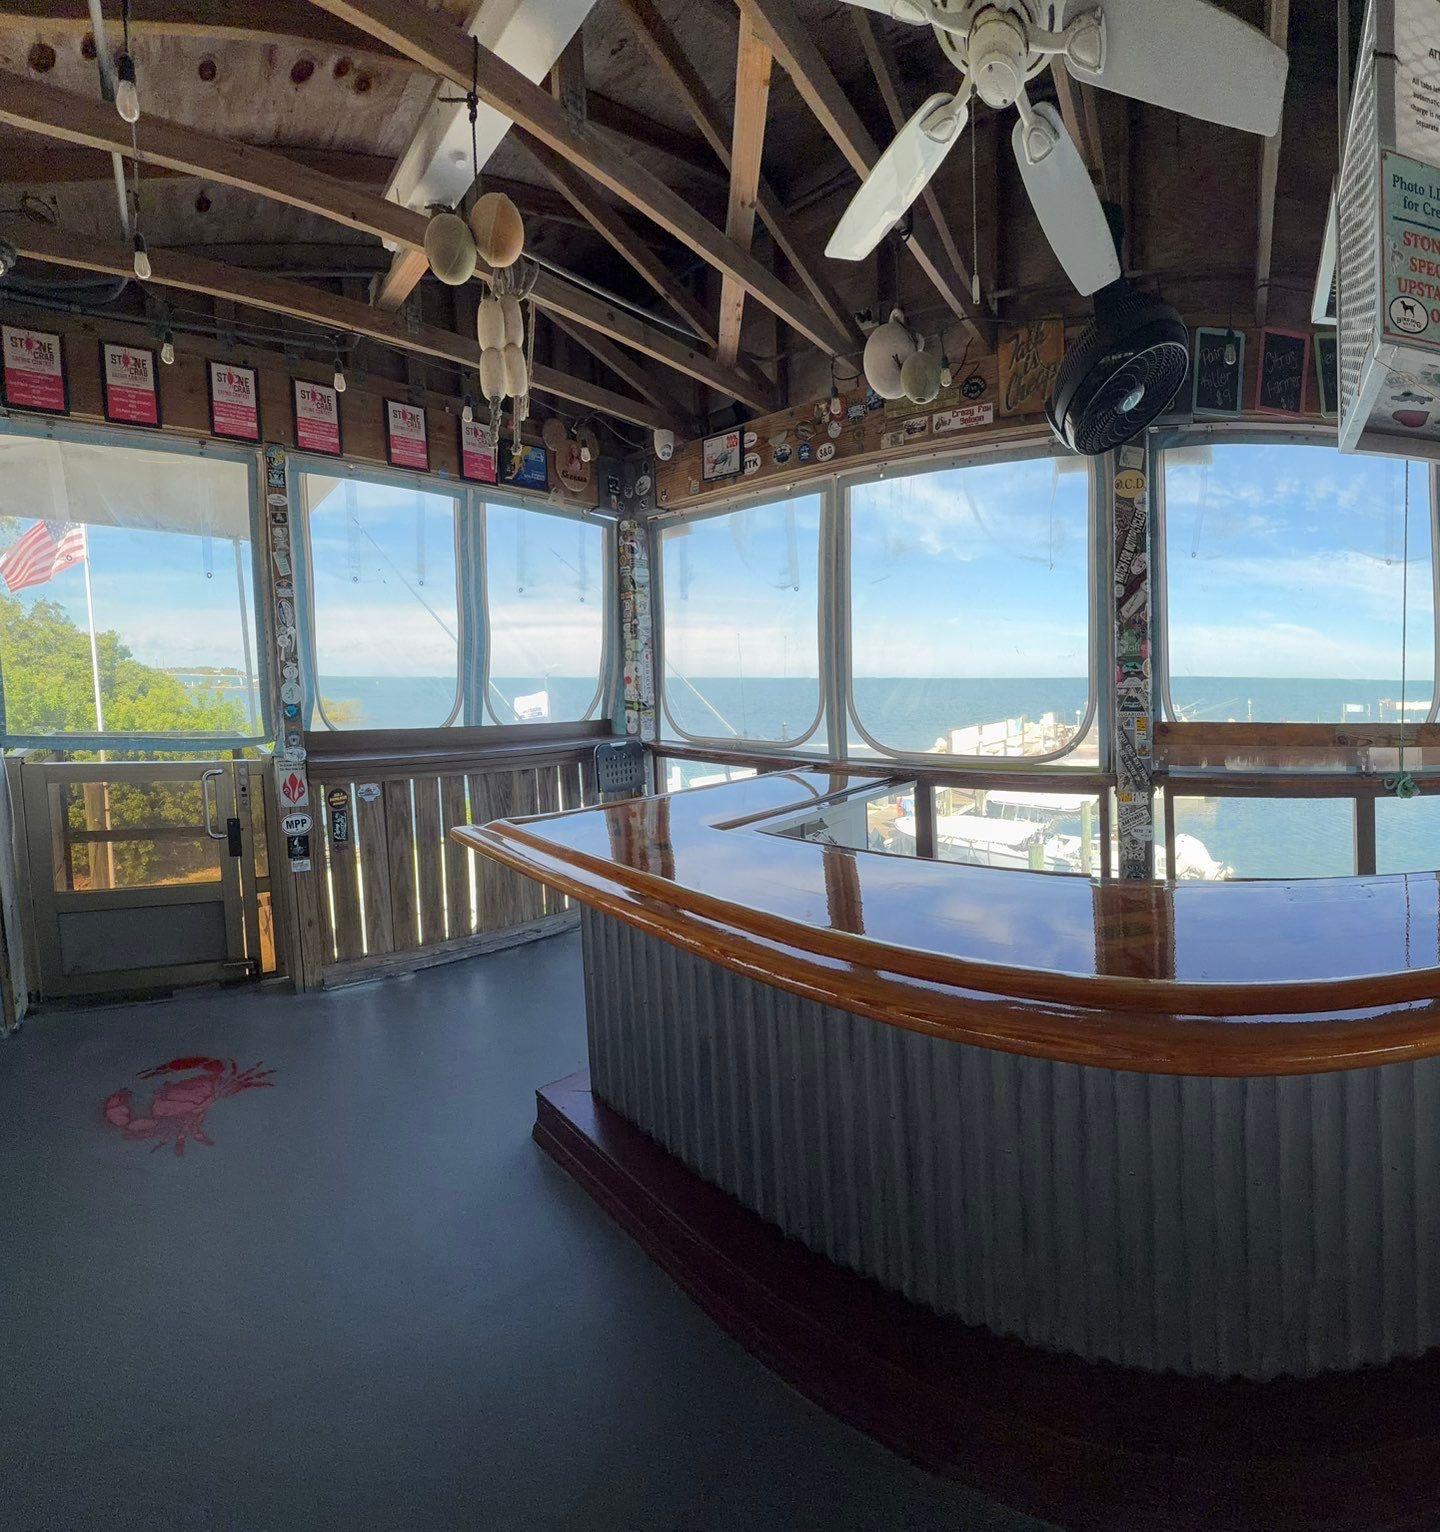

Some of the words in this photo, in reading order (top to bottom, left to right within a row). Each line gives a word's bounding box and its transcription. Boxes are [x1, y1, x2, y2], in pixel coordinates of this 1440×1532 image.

[1420, 80, 1432, 91] tabs
[1412, 92, 1439, 107] automatic
[1410, 104, 1428, 116] charge
[1416, 119, 1439, 132] separate
[1392, 174, 1424, 196] Photo
[1403, 196, 1419, 212] for
[34, 352, 54, 361] CRAB
[129, 368, 148, 377] CRAB
[234, 386, 250, 394] CRAB
[317, 402, 332, 411] CRAB
[952, 409, 974, 418] Crazy
[1124, 510, 1146, 552] MOTORCYCLES
[1120, 549, 1134, 563] FOR
[1116, 560, 1130, 583] WATCH
[286, 819, 307, 830] MPP
